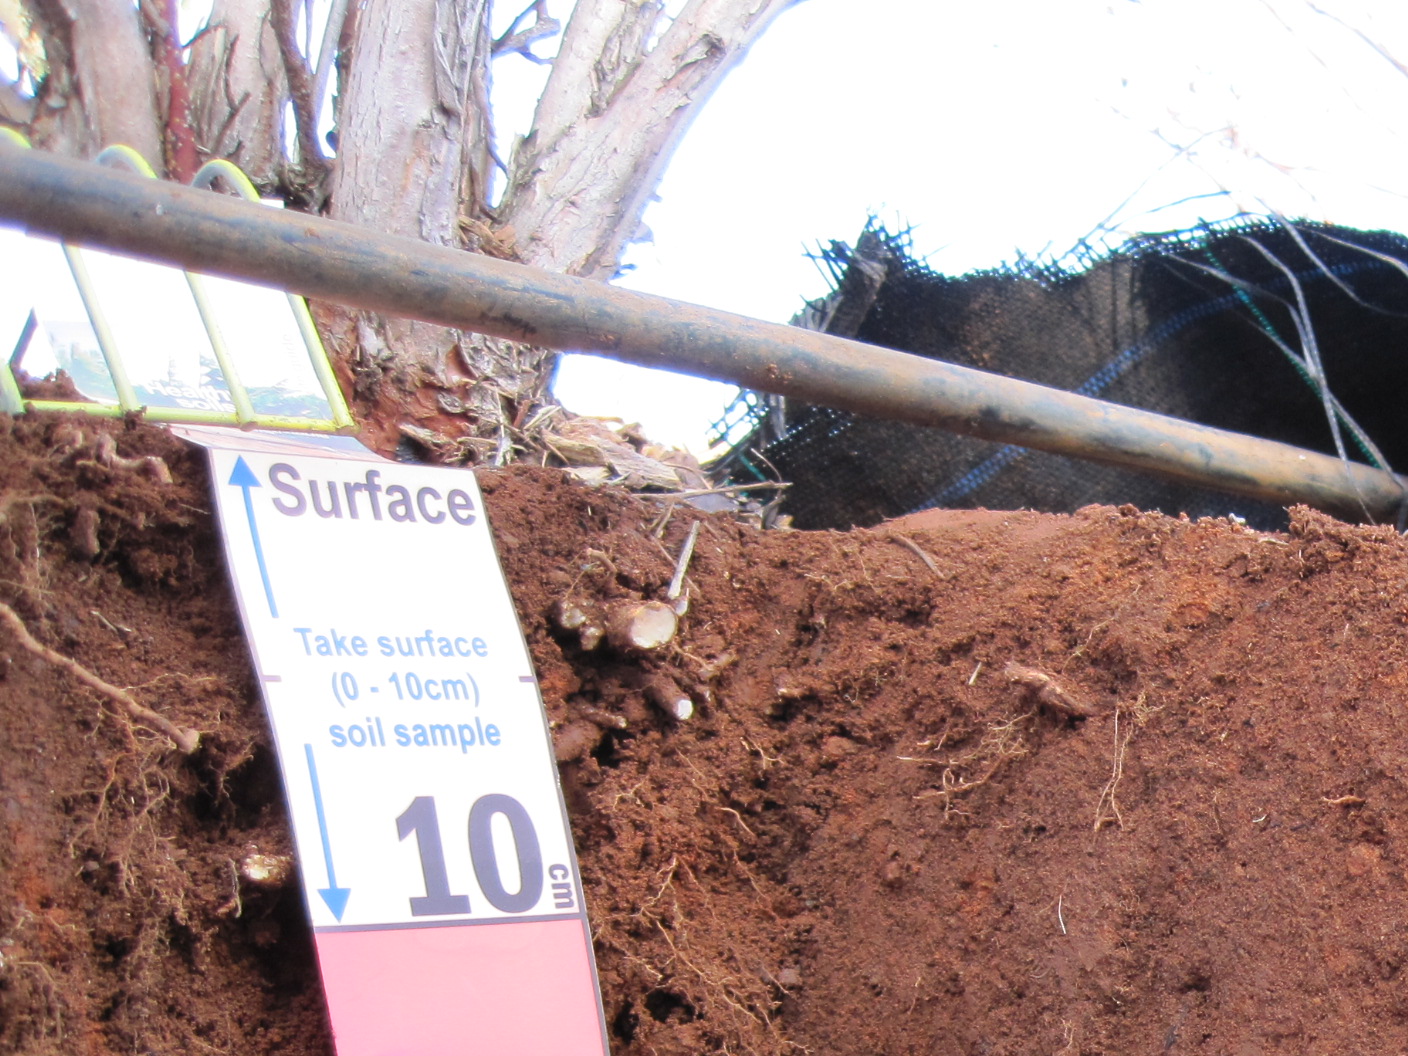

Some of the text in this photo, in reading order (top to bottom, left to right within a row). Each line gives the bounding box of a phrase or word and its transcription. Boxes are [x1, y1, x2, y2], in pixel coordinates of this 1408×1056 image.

[145, 381, 234, 402] Health
[269, 463, 477, 526] Surface
[294, 628, 489, 658] Take surface
[389, 672, 481, 706] 10cm)
[329, 717, 502, 754] soil sample
[396, 793, 576, 917] 10 cm
